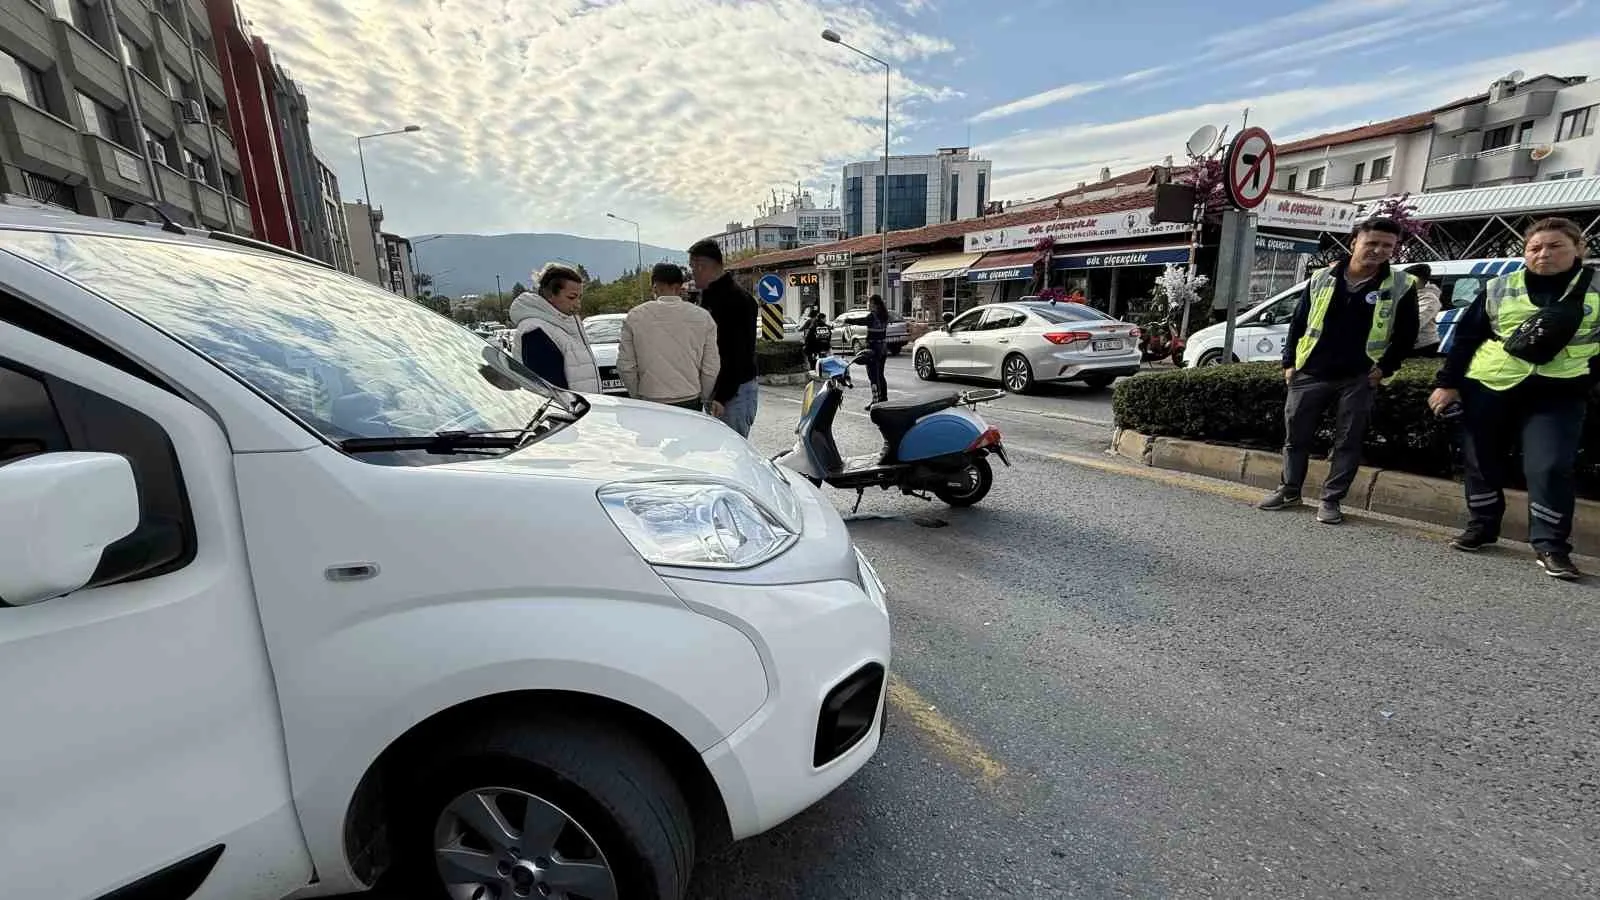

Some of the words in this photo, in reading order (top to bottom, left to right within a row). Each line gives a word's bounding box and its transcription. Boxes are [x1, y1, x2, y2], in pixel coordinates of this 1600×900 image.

[1028, 223, 1044, 234] GÜL
[1046, 218, 1098, 233] ÇİÇEKÇİLİK
[1086, 255, 1100, 265] GÜL
[1103, 252, 1148, 266] ÇİÇEKÇİLİK
[977, 271, 988, 280] GÜL
